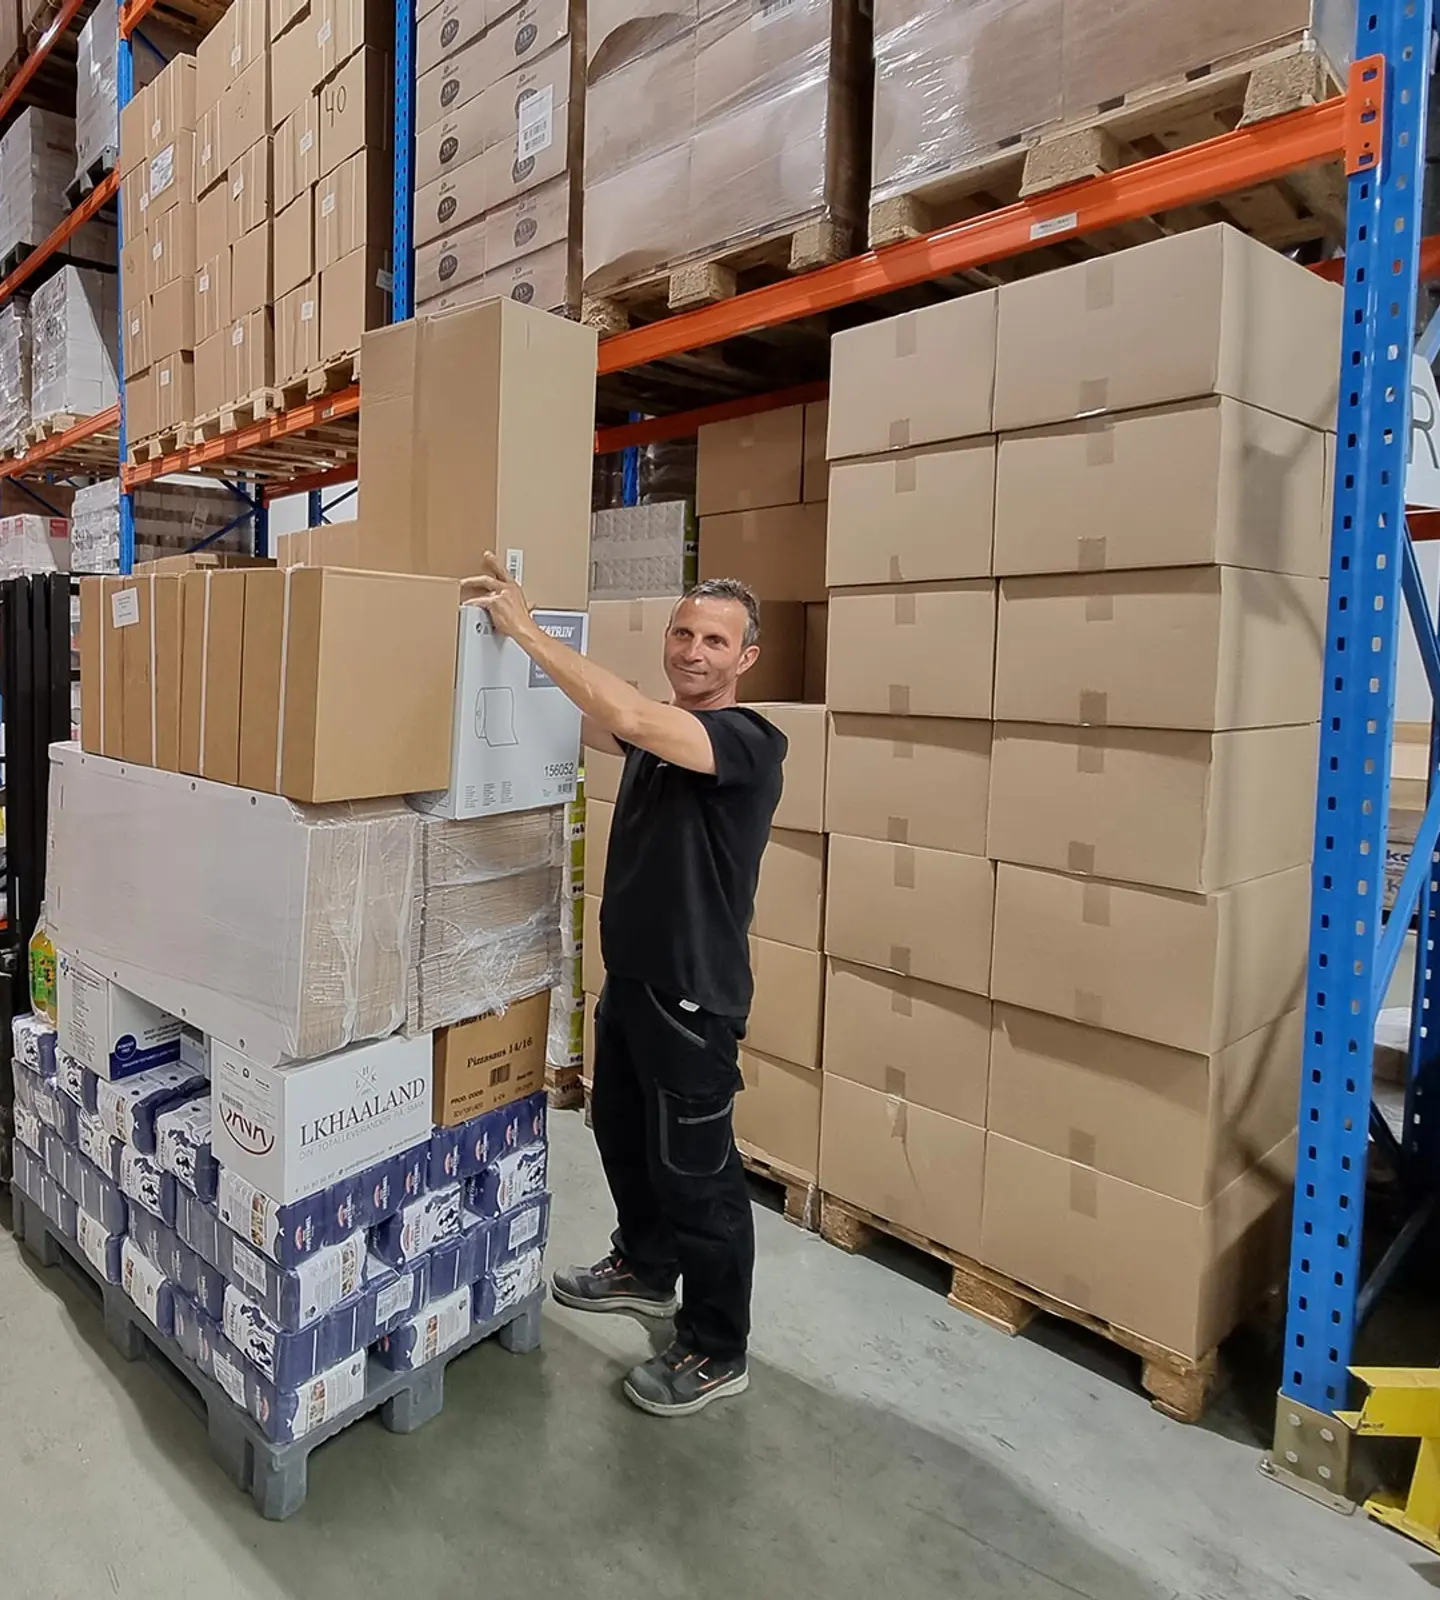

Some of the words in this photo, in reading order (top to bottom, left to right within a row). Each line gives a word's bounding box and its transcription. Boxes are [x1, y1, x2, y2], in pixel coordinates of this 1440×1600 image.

[324, 85, 347, 128] 40
[544, 762, 575, 777] 156052
[300, 1077, 425, 1147] LKHAALAND
